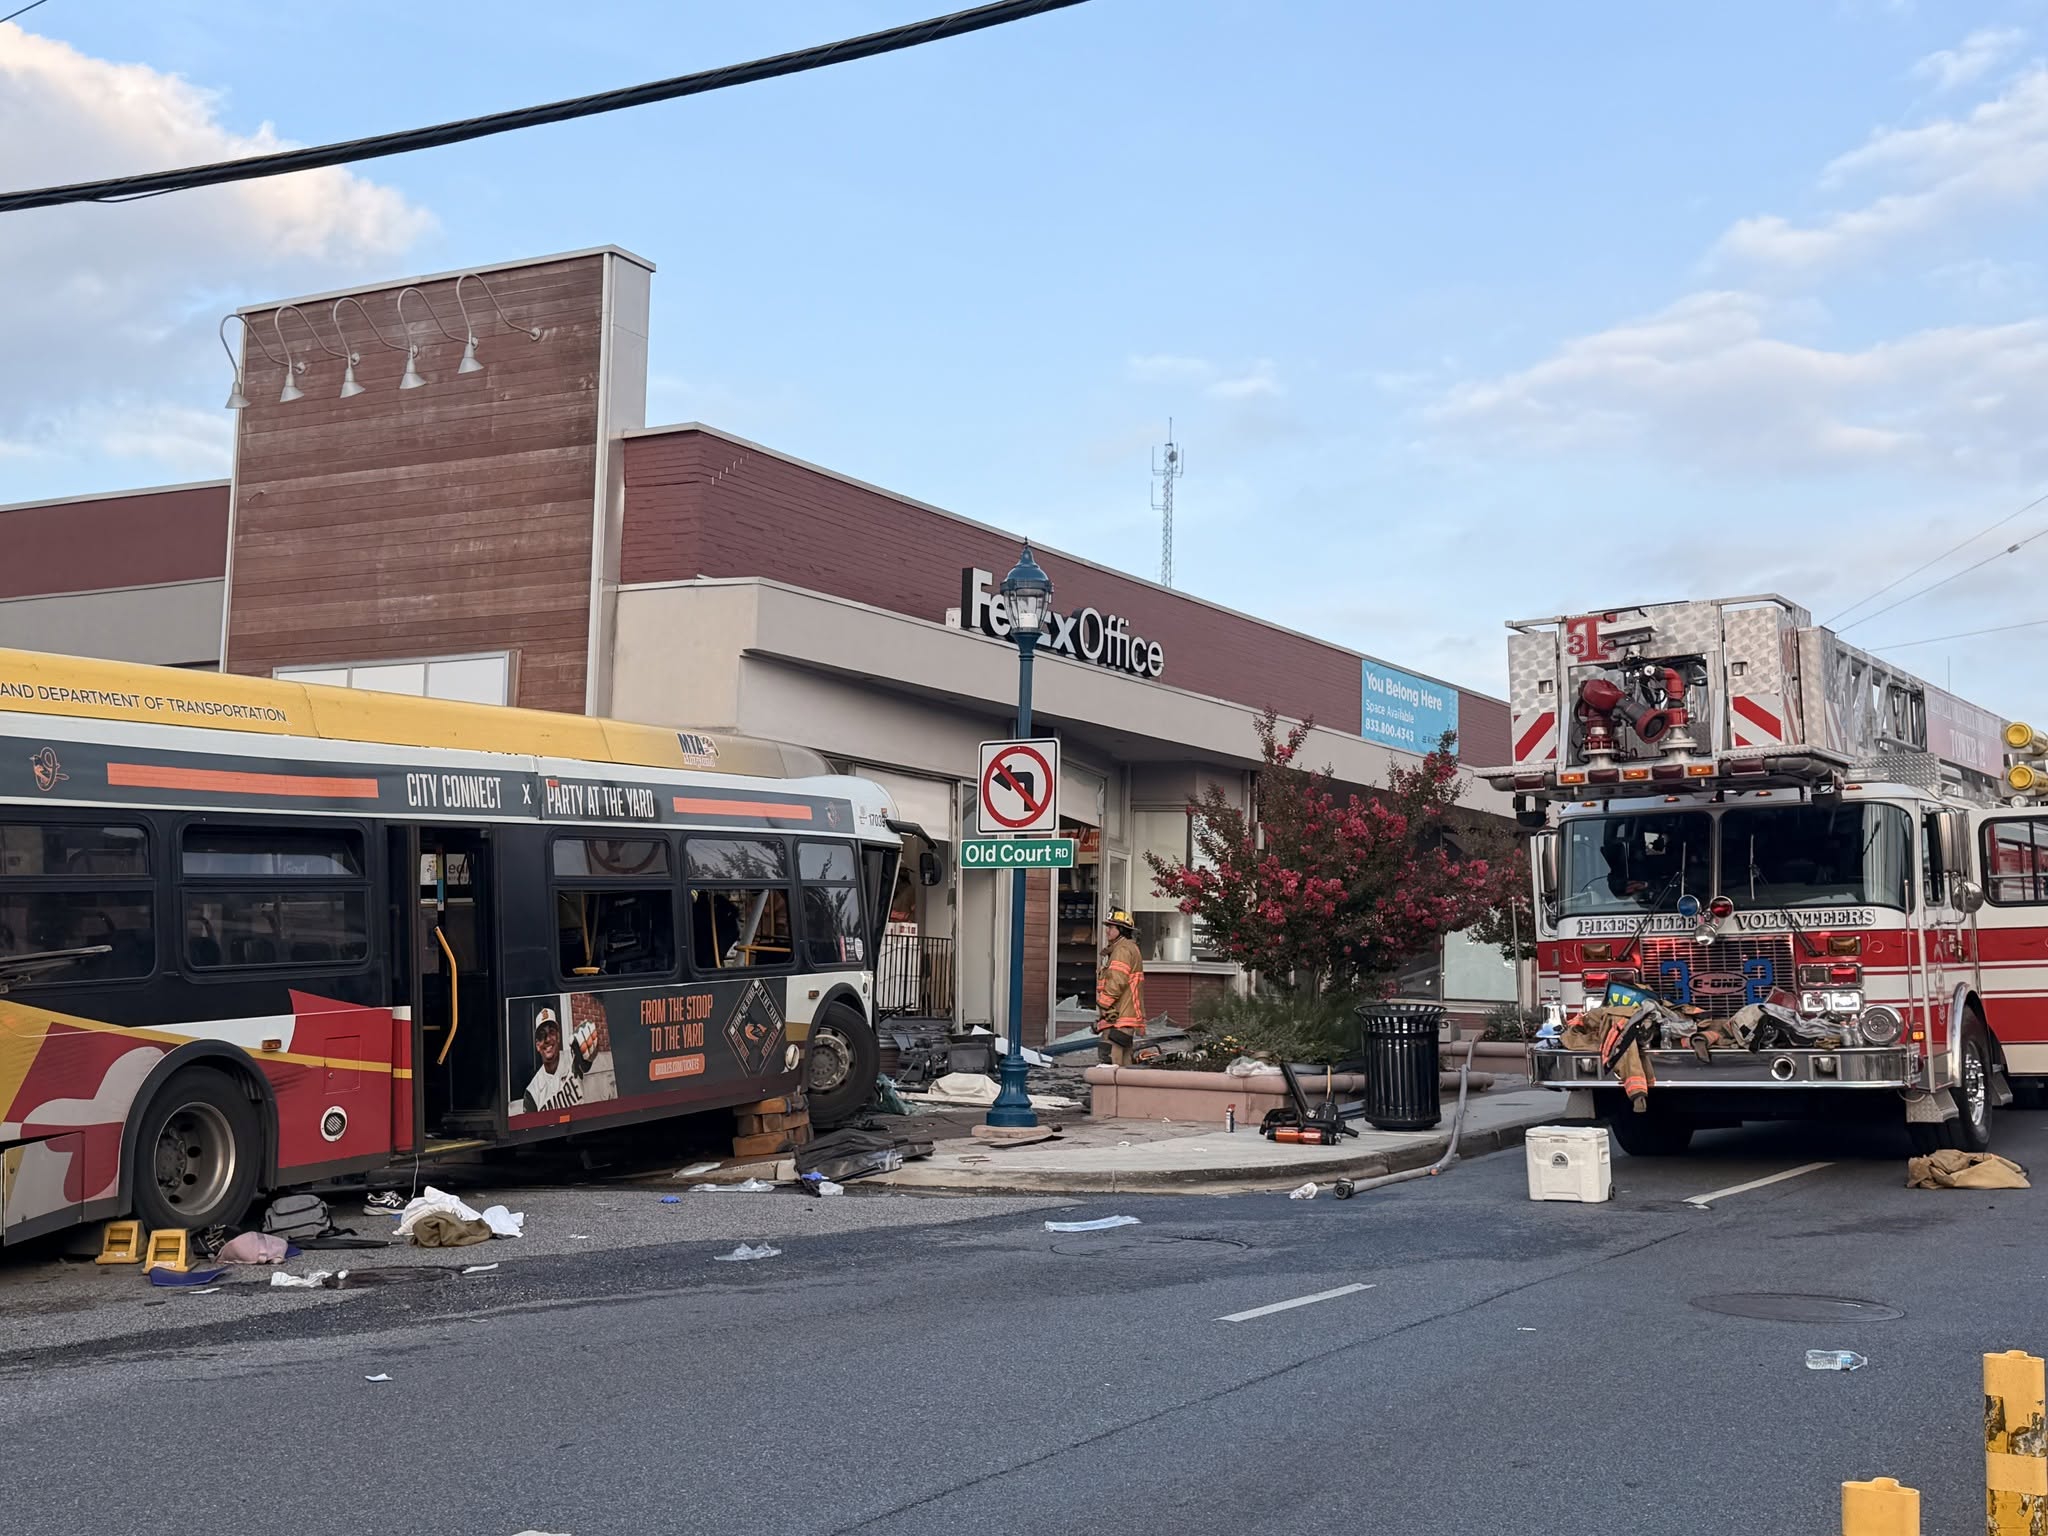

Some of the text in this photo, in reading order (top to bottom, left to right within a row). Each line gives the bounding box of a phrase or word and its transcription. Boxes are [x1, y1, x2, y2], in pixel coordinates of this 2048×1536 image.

[967, 567, 1165, 677] Fex Office
[37, 685, 140, 709] DEPARTMENT
[144, 696, 164, 710] OF
[167, 698, 287, 722] TRANSPORTATION
[1365, 671, 1443, 711] You Belong Here
[1365, 699, 1415, 724] Space Available
[676, 732, 706, 756] MTA
[1365, 718, 1415, 742] 833.800.4343
[407, 773, 438, 807] CITY
[442, 775, 502, 809] CONNECT
[545, 778, 584, 815] PARTY
[587, 785, 602, 816] AT
[602, 786, 623, 817] THE
[625, 788, 655, 818] YARD
[965, 844, 1068, 863] Old Court RD
[1580, 908, 1876, 936] PIKESVILLE VOLUNTEERS
[1661, 957, 1773, 1005] 3 2
[1693, 978, 1743, 989] E-ONE
[641, 994, 713, 1025] FROM THE STOOP
[650, 1027, 662, 1053] TO
[664, 1025, 680, 1051] THE
[682, 1022, 704, 1049] YARD
